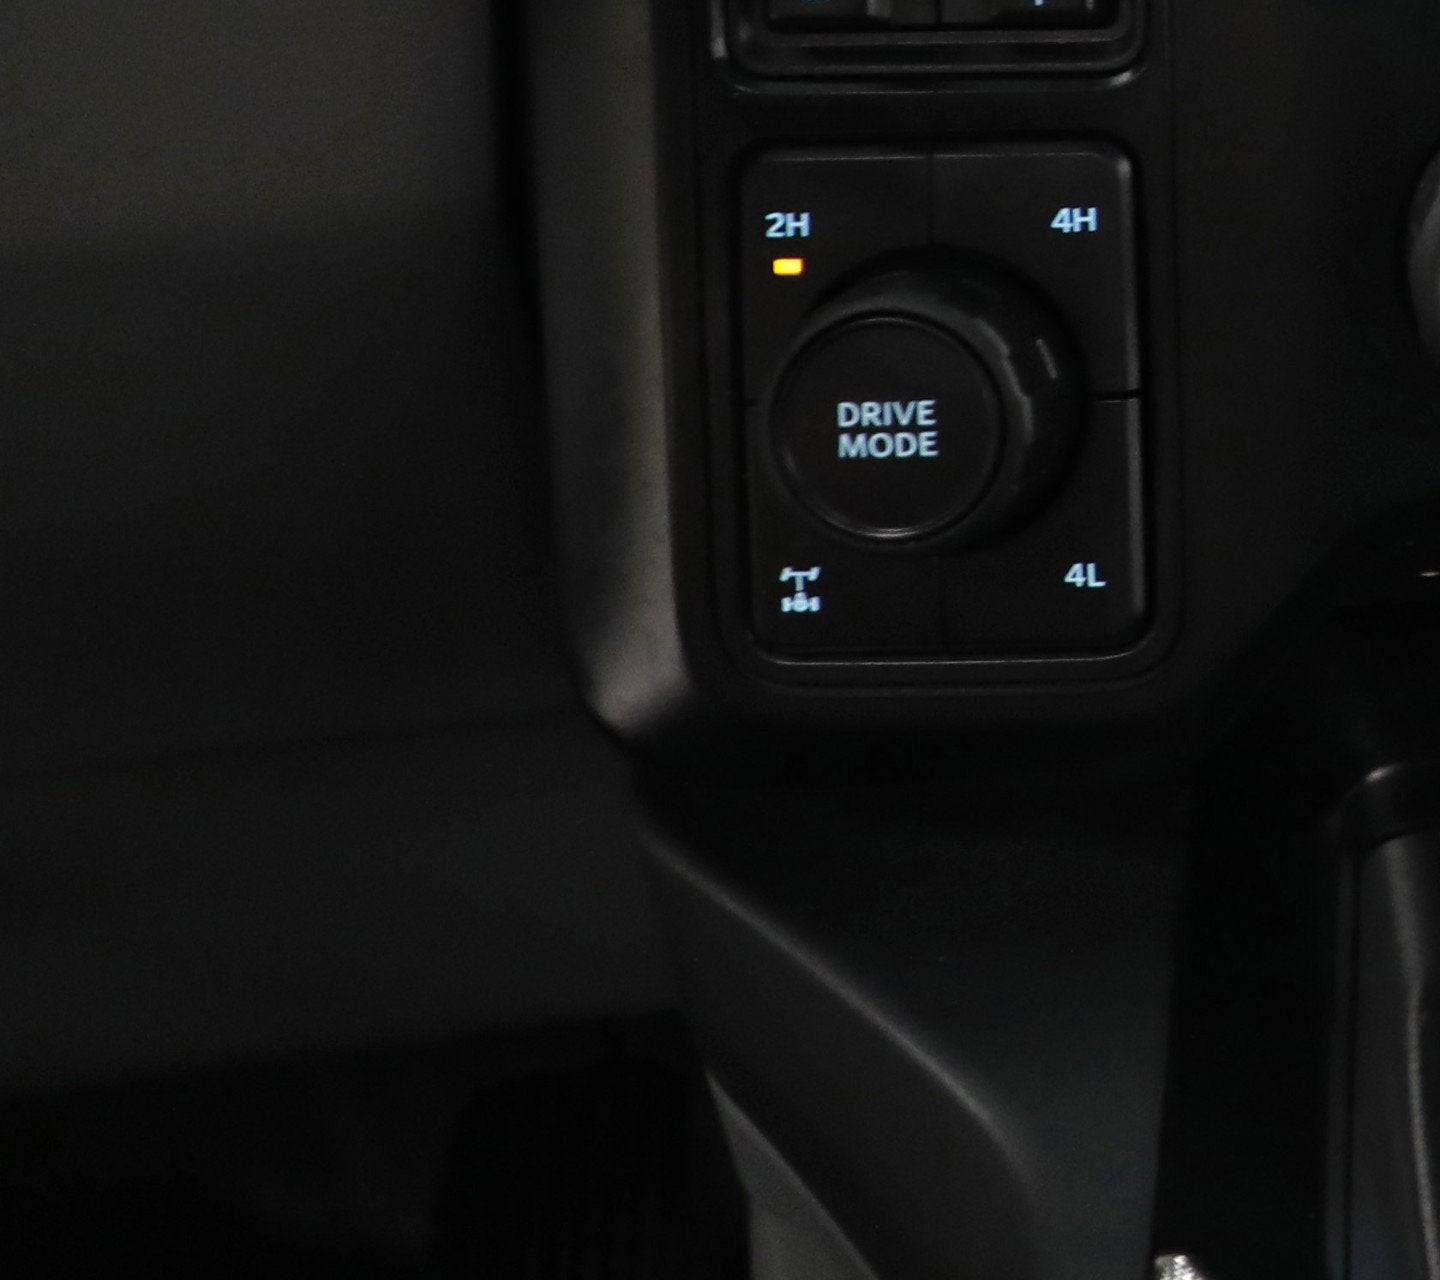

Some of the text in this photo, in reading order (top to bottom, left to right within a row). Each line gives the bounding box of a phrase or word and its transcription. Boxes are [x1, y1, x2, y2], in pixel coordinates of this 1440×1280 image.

[764, 211, 810, 238] 2H
[1049, 206, 1098, 233] 4H
[836, 398, 937, 428] DRIVE
[837, 429, 939, 458] MODE
[1063, 561, 1107, 588] 4L
